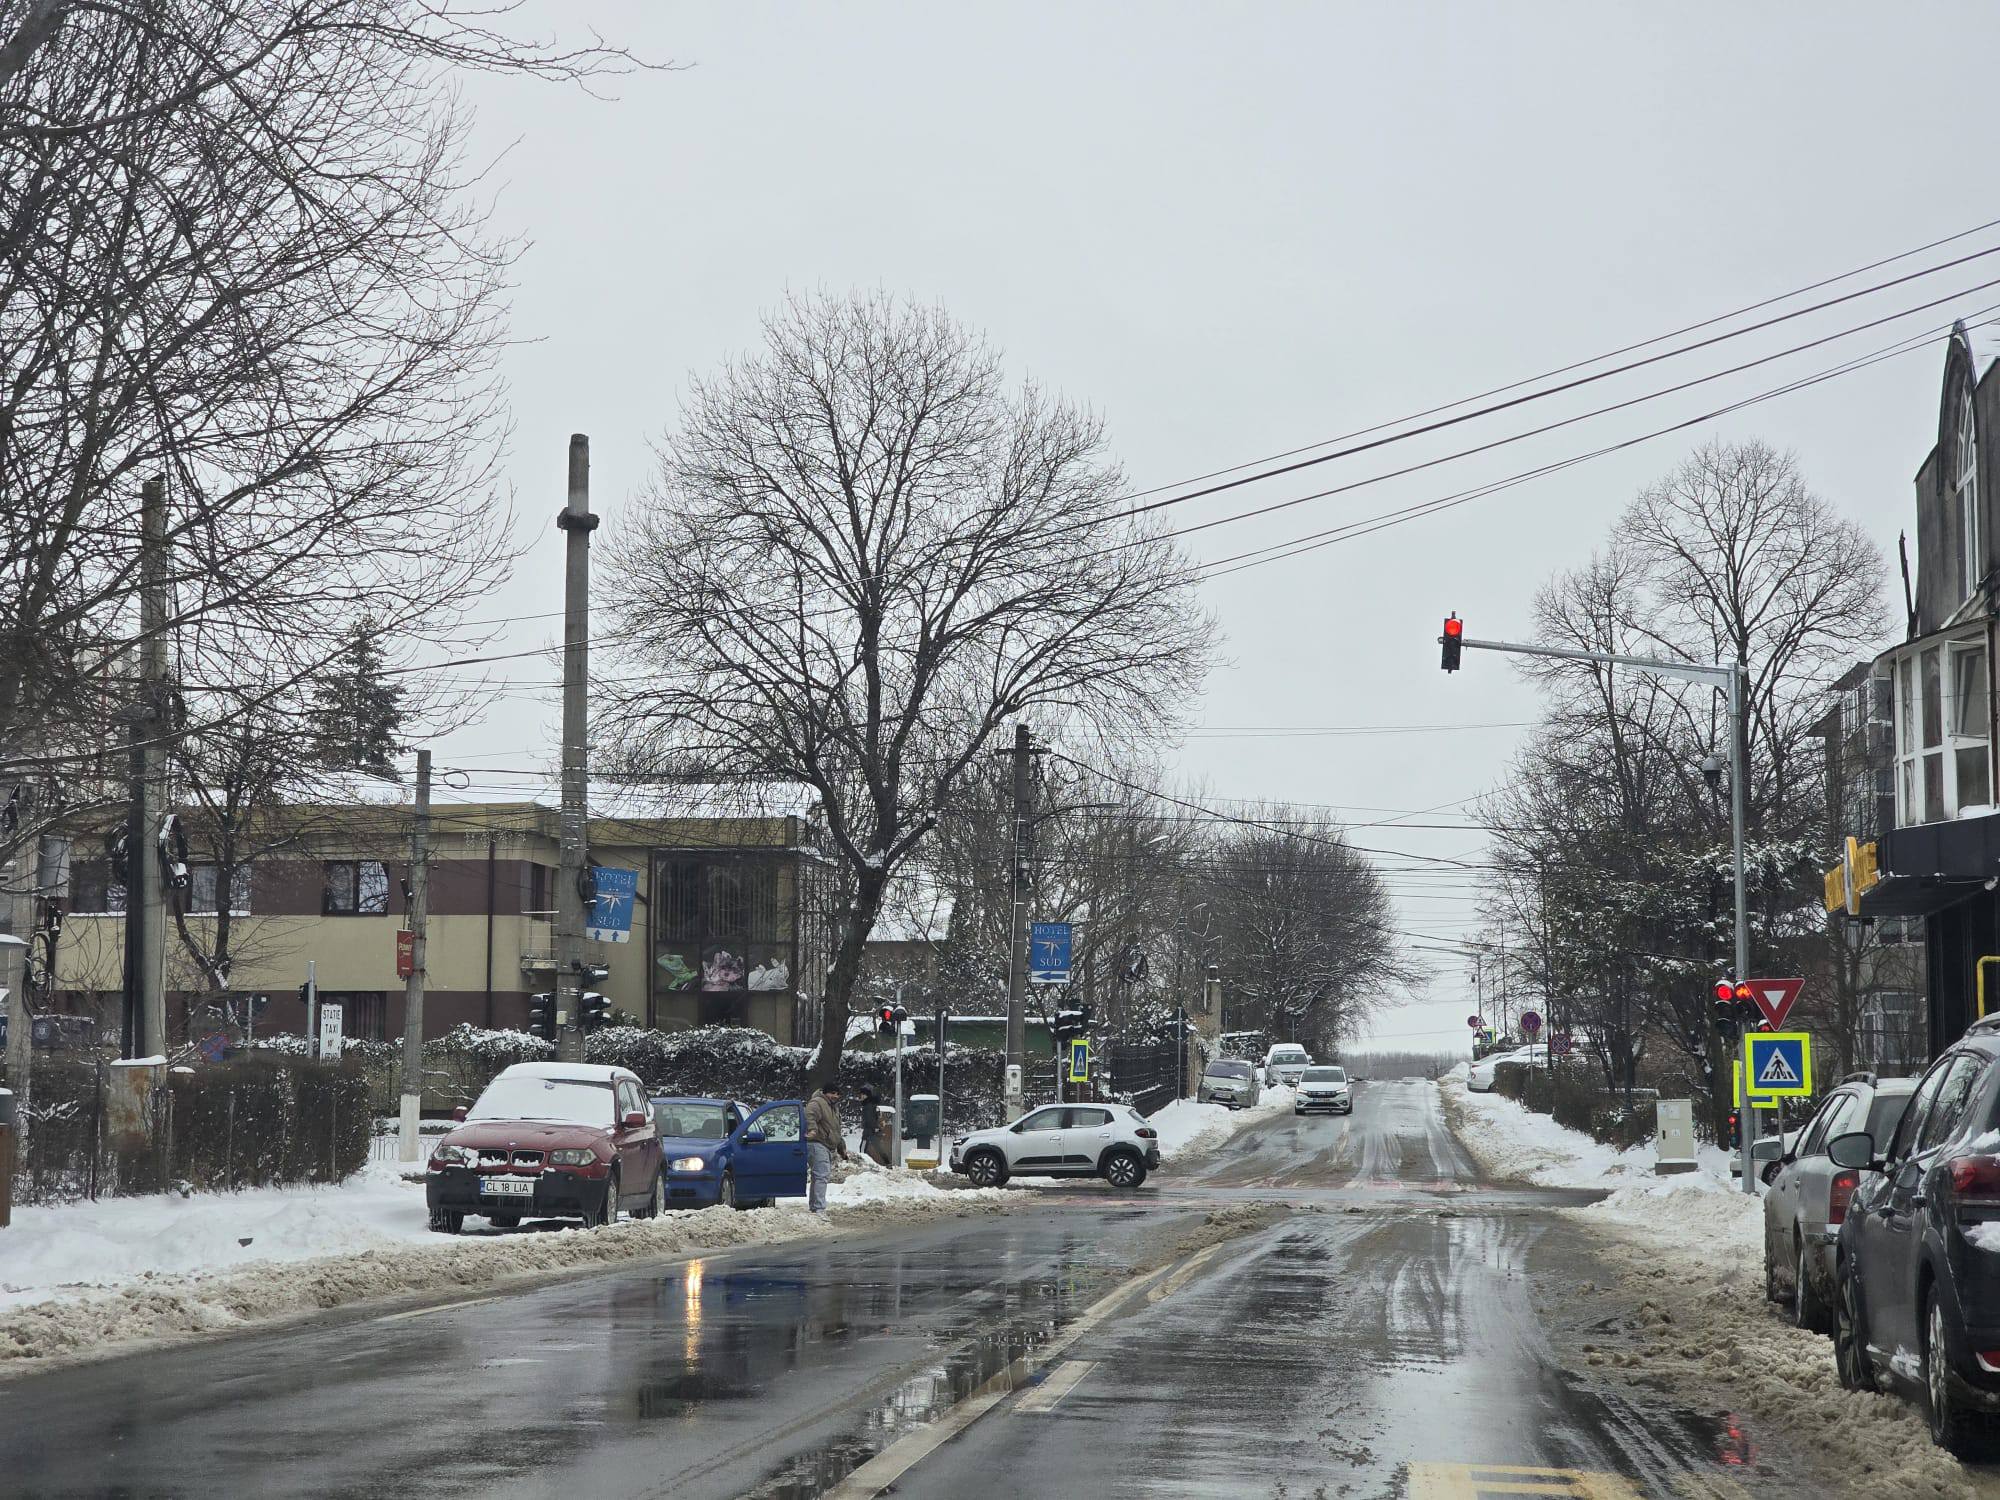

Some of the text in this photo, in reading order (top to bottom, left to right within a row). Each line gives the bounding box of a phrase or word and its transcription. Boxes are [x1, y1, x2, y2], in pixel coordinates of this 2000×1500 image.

[595, 871, 635, 886] HOTEL
[1034, 925, 1070, 935] HOTEL
[1039, 957, 1062, 967] SUD
[325, 1023, 339, 1034] TAXI
[486, 1182, 529, 1193] CL 18 LIA
